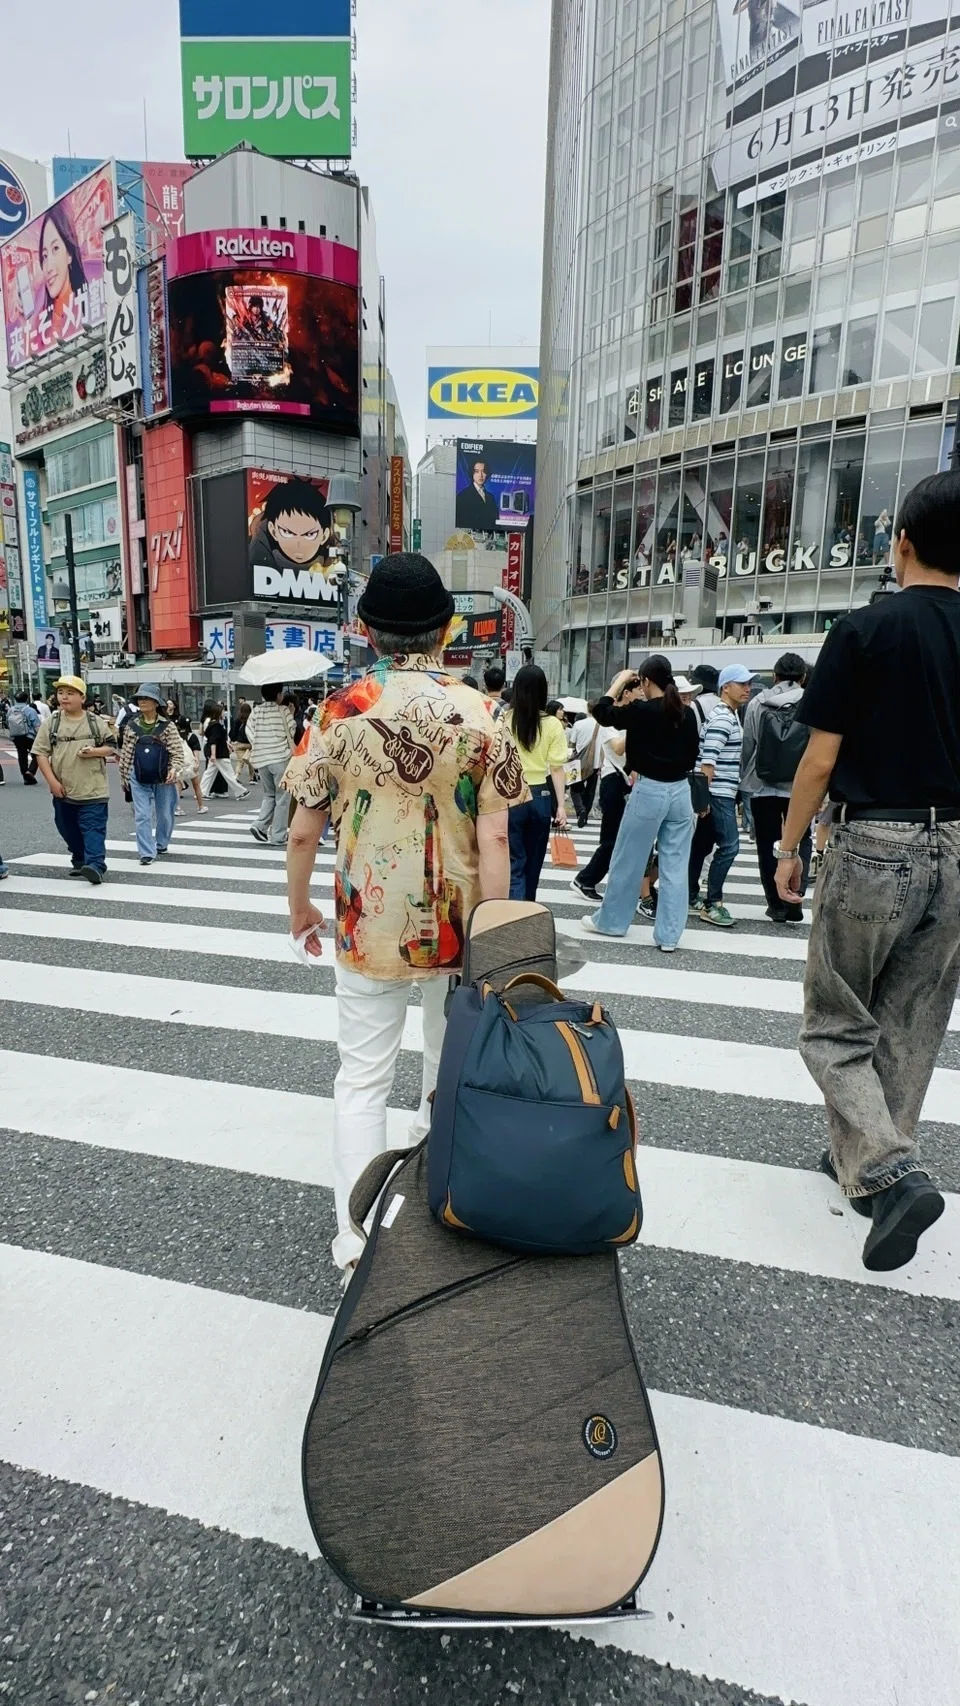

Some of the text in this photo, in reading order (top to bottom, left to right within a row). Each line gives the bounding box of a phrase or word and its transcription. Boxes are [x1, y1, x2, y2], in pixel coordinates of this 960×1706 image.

[818, 0, 910, 43] FINAL FANTASY
[192, 75, 341, 120] サロンパス
[747, 45, 960, 160] 6月13日発売
[162, 185, 184, 210] 龍
[215, 235, 295, 259] Rakuten
[105, 225, 136, 387] もんじゃ
[440, 383, 536, 403] IKEA
[649, 343, 808, 402] SHARE LOUNGE
[236, 401, 280, 410] Rakuten Vision
[461, 442, 484, 452] EDIFIER
[393, 459, 401, 530] クスリのことなら
[26, 490, 42, 584] サマーフルーツギフト
[151, 511, 184, 593] クスリ
[509, 541, 520, 595] カラオケ
[616, 543, 850, 589] STABUCKS
